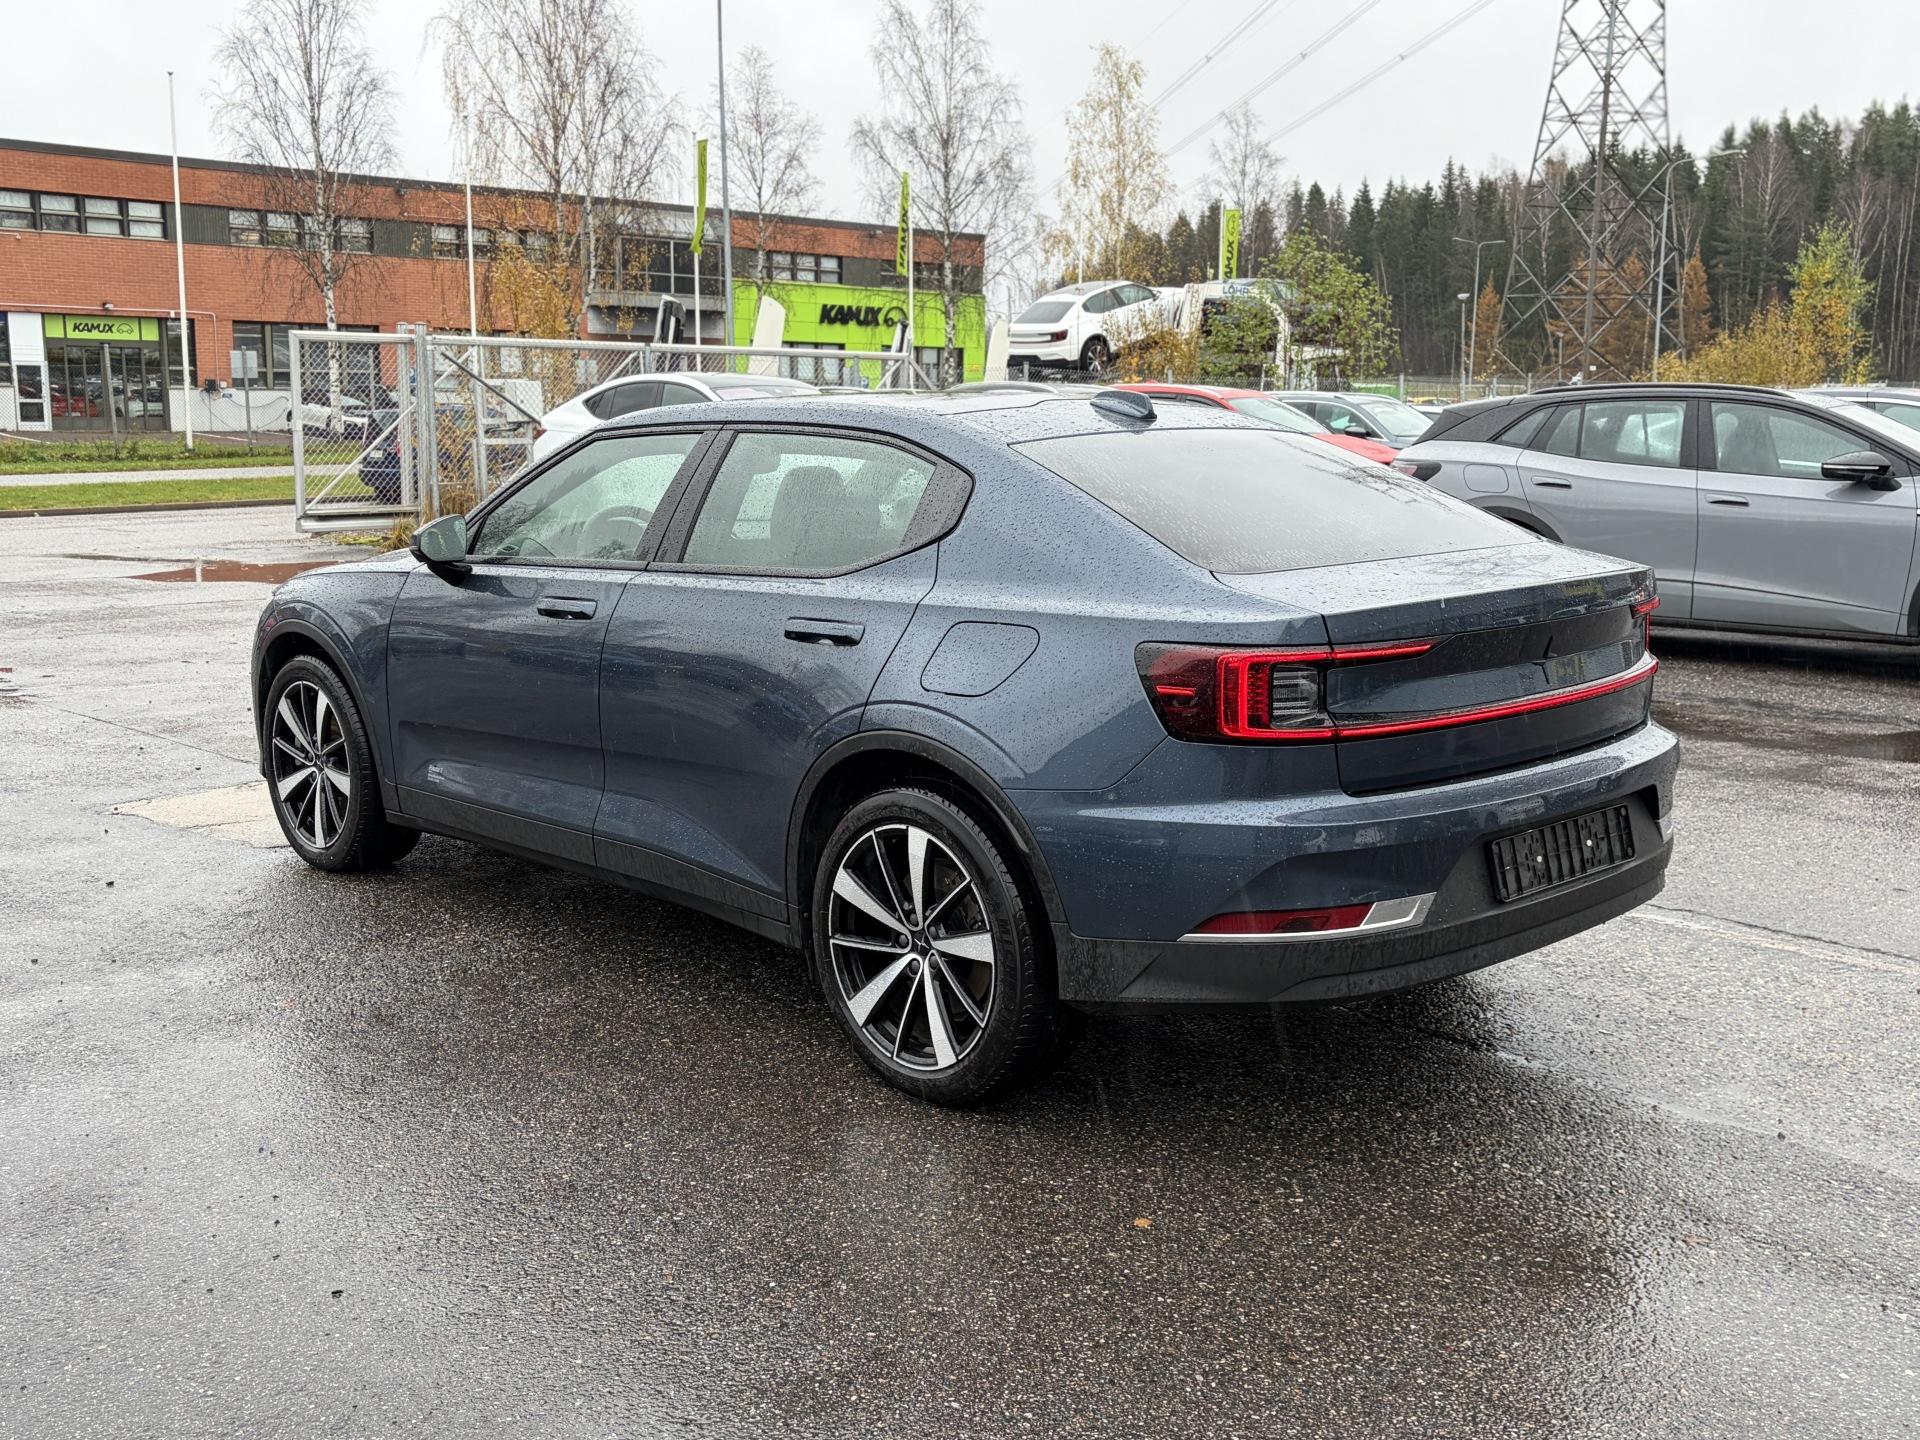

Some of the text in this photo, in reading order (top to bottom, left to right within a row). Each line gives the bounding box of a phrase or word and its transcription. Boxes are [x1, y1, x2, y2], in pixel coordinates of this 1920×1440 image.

[1224, 239, 1235, 279] AMUX
[820, 304, 883, 326] KAMUX
[72, 322, 115, 333] KAMUX
